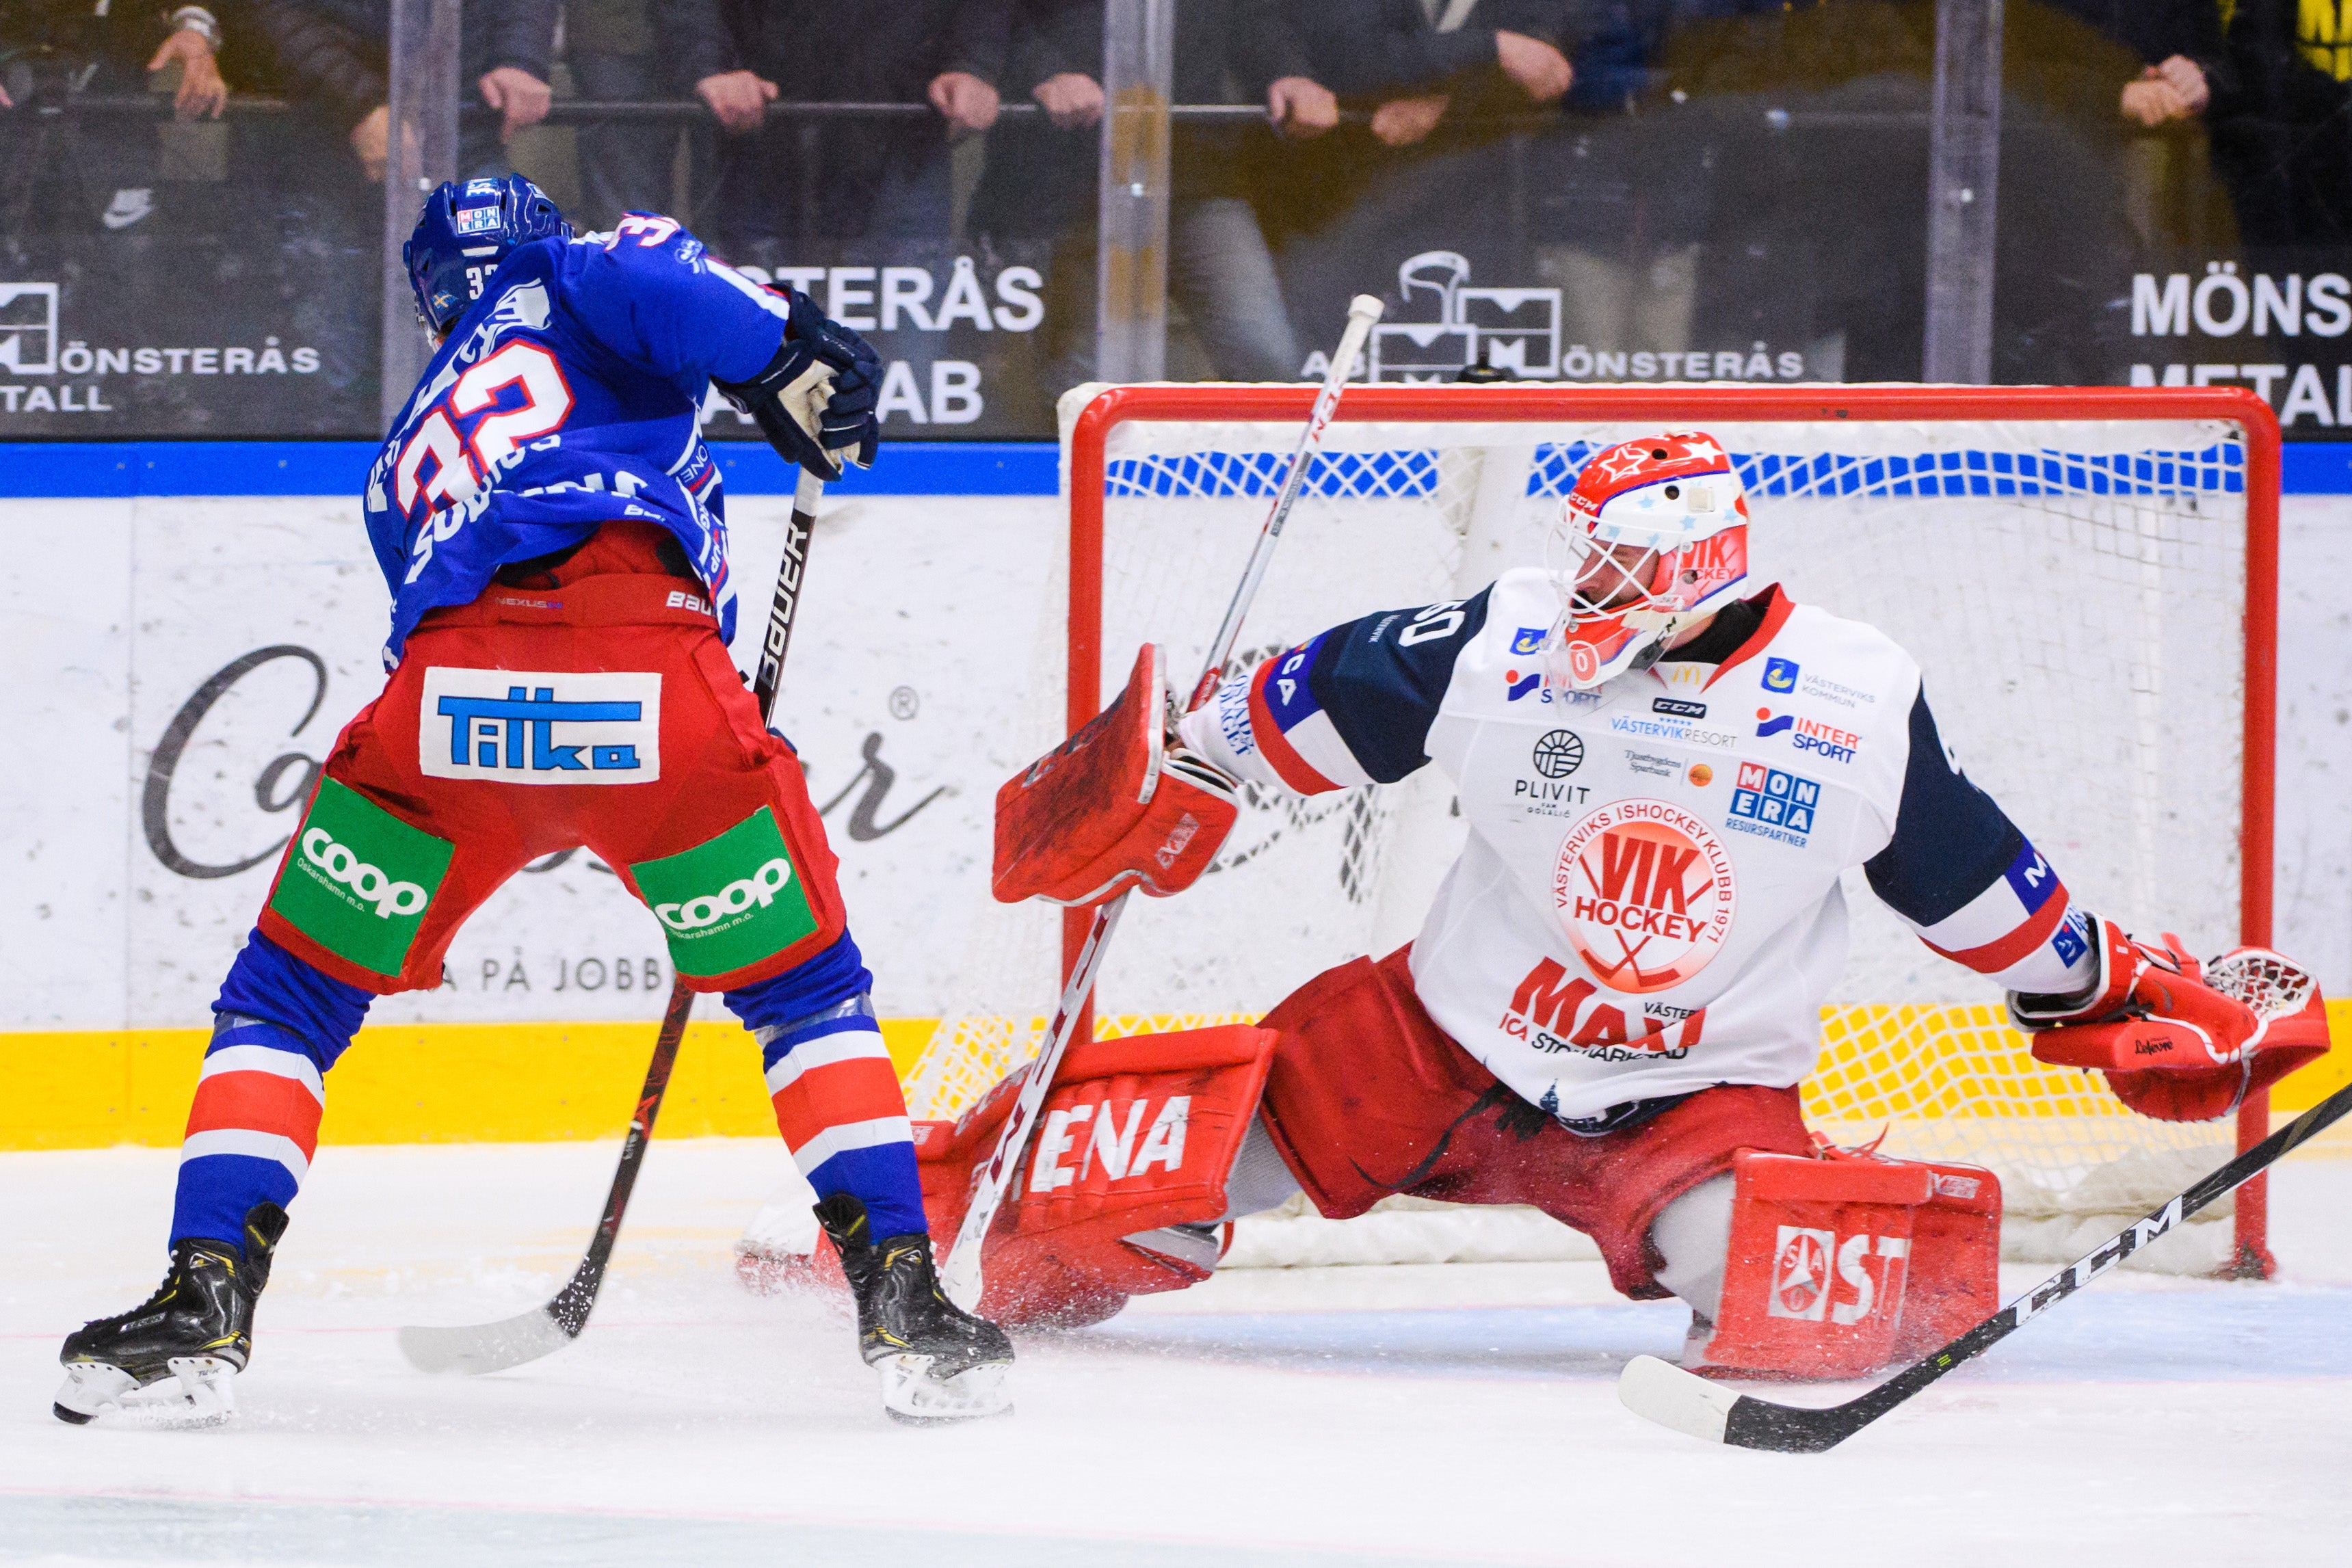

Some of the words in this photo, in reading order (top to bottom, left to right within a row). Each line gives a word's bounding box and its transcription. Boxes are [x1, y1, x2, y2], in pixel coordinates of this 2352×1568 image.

[459, 207, 499, 222] MON
[460, 217, 499, 231] ERA
[2132, 261, 2352, 337] MÖNS
[0, 385, 112, 412] TALL
[876, 360, 983, 423] AB
[395, 338, 576, 521] 32
[1570, 492, 1598, 511] CCM
[1671, 567, 1737, 581] HCKEY
[1654, 700, 1706, 716] CCM
[1792, 733, 1857, 765] SPORT
[1797, 717, 1860, 749] INTER
[1515, 780, 1591, 804] PLIVIT
[1737, 762, 1819, 808] MON
[1735, 790, 1812, 833] ERA
[1726, 818, 1808, 849] RESURSPARTNER
[297, 858, 346, 900] Oskarshamn
[302, 827, 427, 919] coop
[1557, 812, 1612, 909] VÄSTERVIKS
[1602, 832, 1700, 915] VIK
[655, 858, 791, 930] coop
[1575, 896, 1708, 942] HOCKEY
[481, 946, 531, 992] PÅ
[553, 957, 662, 992] JOBB
[1499, 1013, 1528, 1041] ICA
[1014, 1096, 1191, 1201] ENA
[2016, 1194, 2183, 1327] CCM
